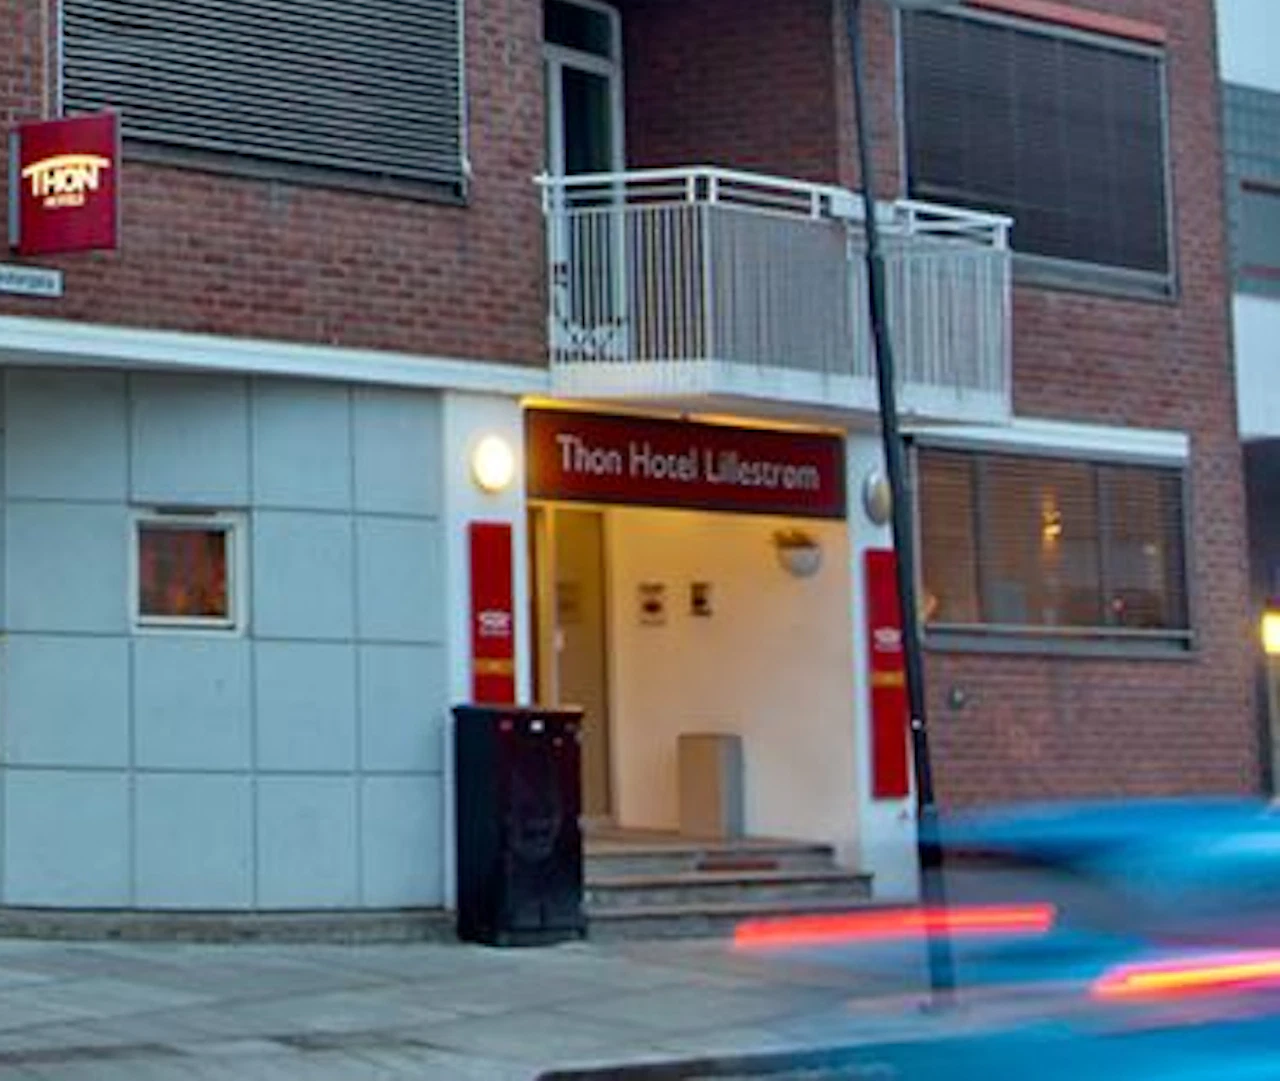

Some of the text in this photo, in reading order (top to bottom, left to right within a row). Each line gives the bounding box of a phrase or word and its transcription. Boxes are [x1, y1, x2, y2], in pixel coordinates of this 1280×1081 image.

[21, 154, 111, 197] THON
[555, 433, 623, 475] Thon
[629, 441, 699, 482] Hotel
